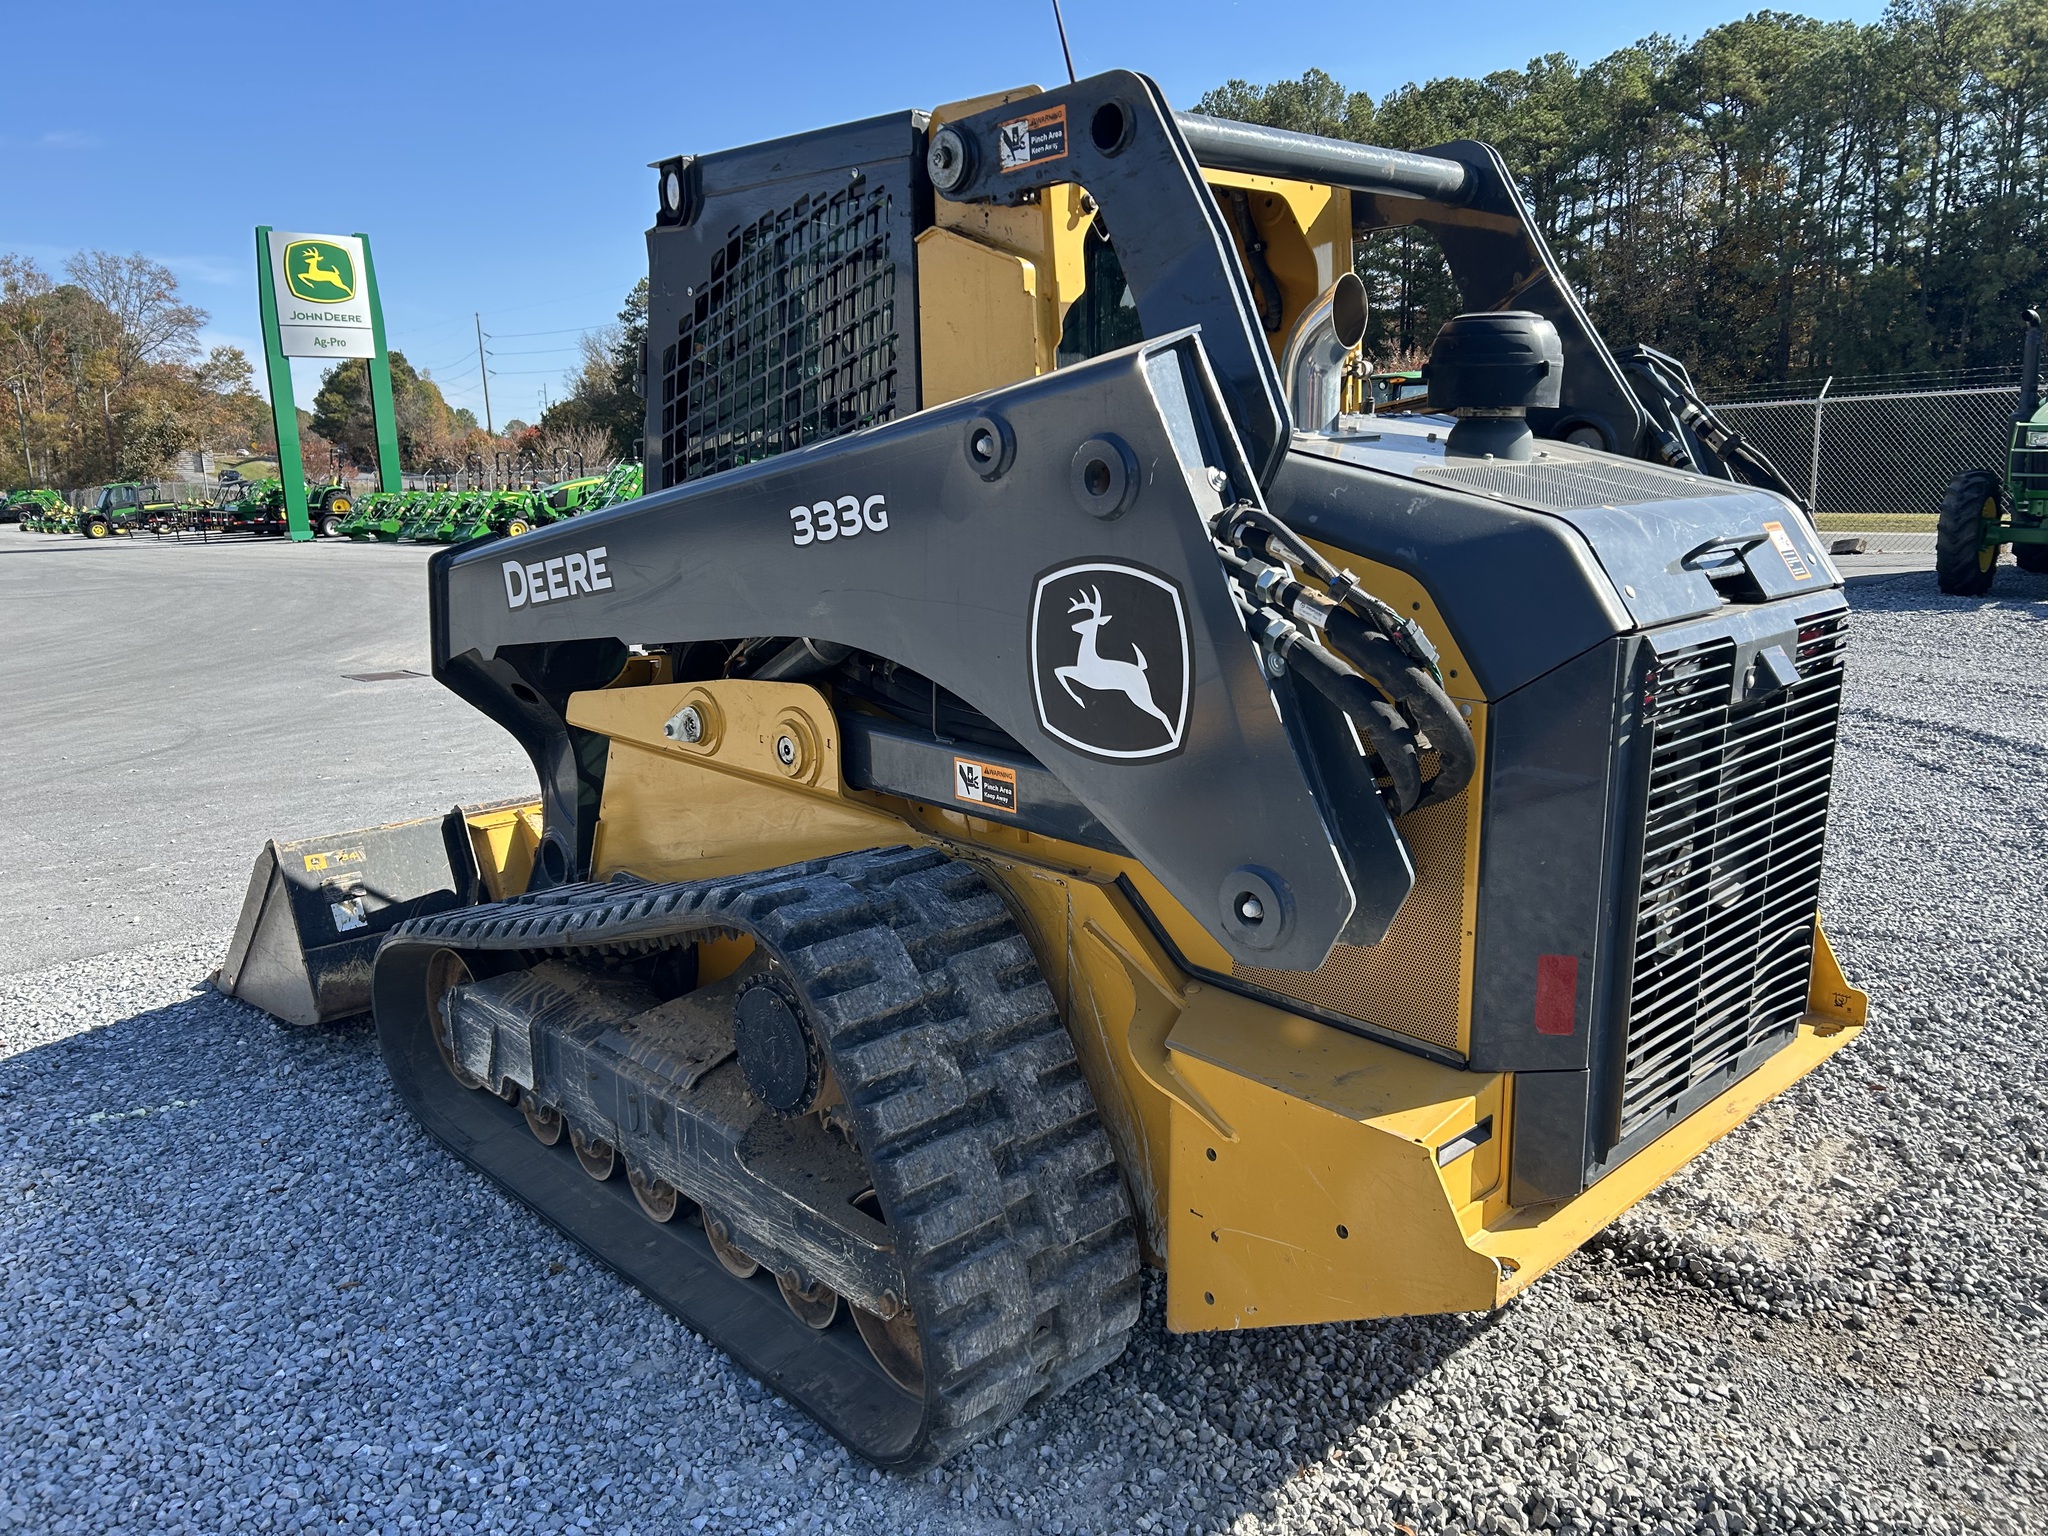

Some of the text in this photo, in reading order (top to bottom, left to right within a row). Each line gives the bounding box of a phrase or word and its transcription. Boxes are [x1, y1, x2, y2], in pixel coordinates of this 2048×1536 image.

[1031, 130, 1063, 144] Pinch Area
[290, 311, 362, 322] JOHN DEERE
[314, 337, 347, 348] Ag-Pro
[789, 494, 889, 546] 333G
[502, 546, 613, 609] DEERE
[988, 769, 1013, 780] WARNING
[984, 782, 1013, 796] Pinch Area
[984, 792, 1009, 804] Keep Away
